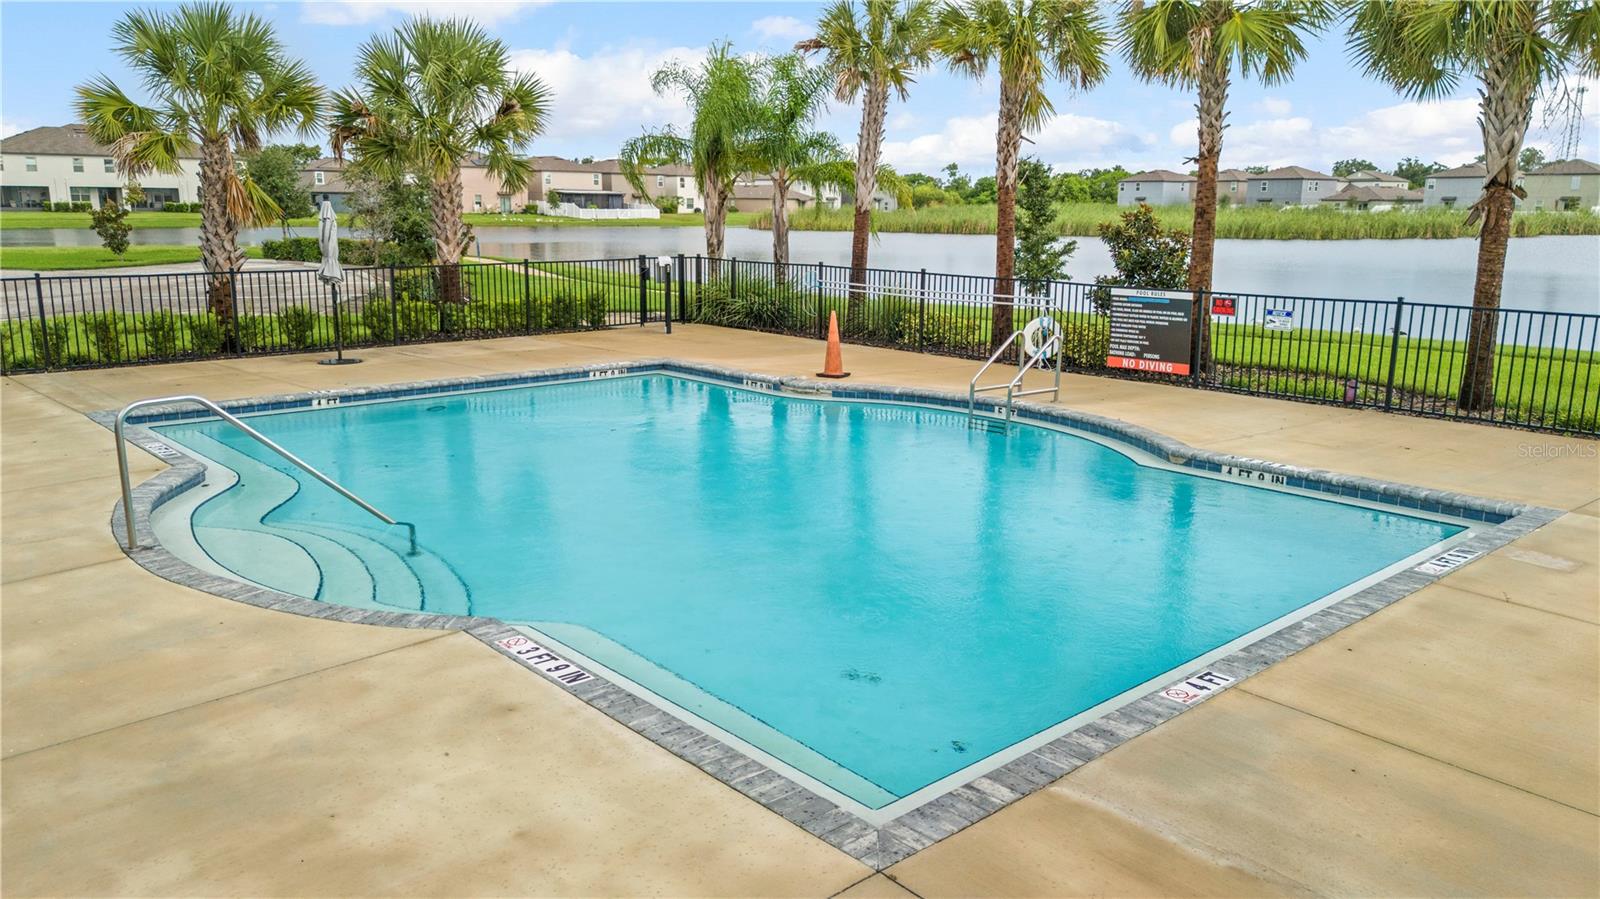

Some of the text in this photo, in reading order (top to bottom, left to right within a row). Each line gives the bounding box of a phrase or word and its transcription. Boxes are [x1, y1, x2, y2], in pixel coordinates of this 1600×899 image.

[1122, 358, 1173, 373] NO DIVING
[516, 646, 591, 684] 3 FT 9 IN
[1185, 671, 1230, 691] 4 FT
